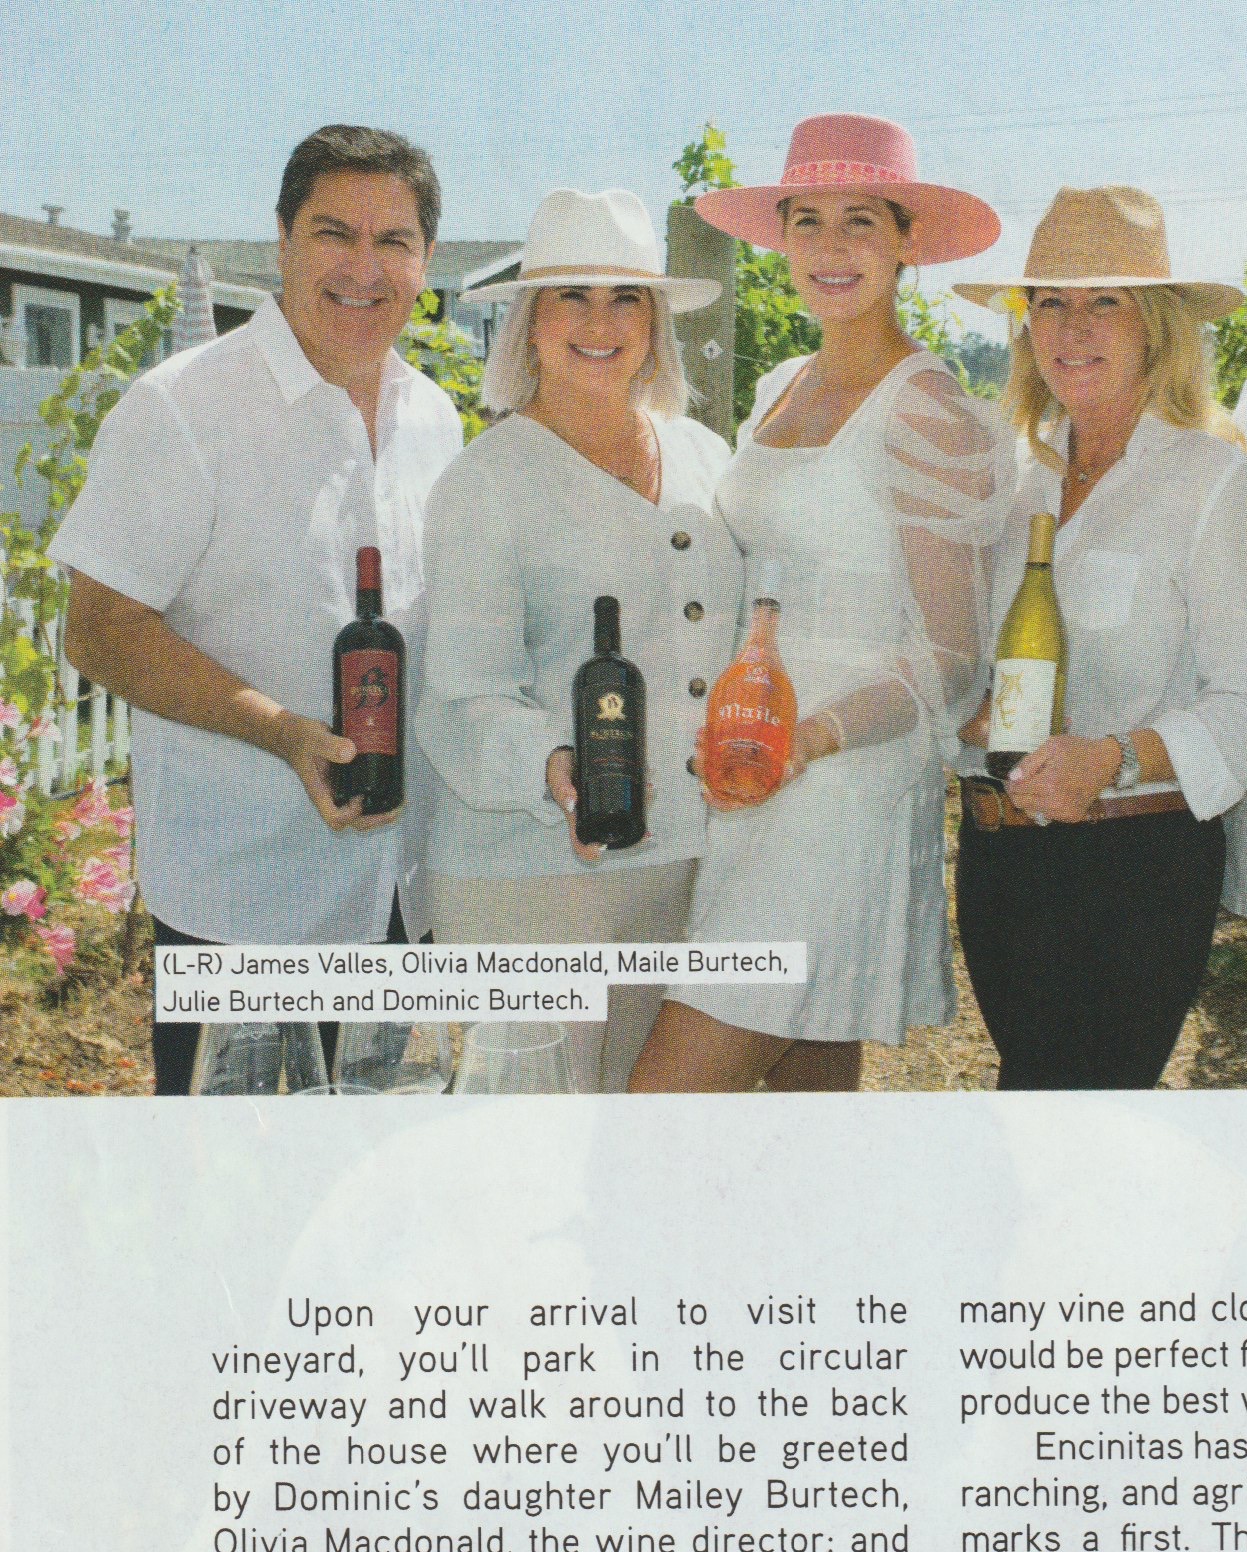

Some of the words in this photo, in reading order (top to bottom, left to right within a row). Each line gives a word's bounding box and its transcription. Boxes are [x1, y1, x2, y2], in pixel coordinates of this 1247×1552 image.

[288, 1297, 373, 1336] Upon
[414, 1305, 489, 1336] your
[530, 1296, 637, 1327] arrival
[677, 1298, 707, 1326] to
[747, 1294, 816, 1325] visit
[856, 1294, 907, 1324] the
[959, 1339, 1055, 1370] would
[1067, 1339, 1103, 1369] be
[1115, 1338, 1229, 1377] perfect
[213, 1390, 367, 1428] driveway
[388, 1389, 446, 1419] and
[469, 1389, 547, 1419] walk
[569, 1388, 684, 1419] around
[705, 1390, 736, 1418] to
[757, 1387, 808, 1417] the
[832, 1386, 908, 1417] back
[961, 1477, 1108, 1514] ranching,
[1122, 1476, 1178, 1506] and
